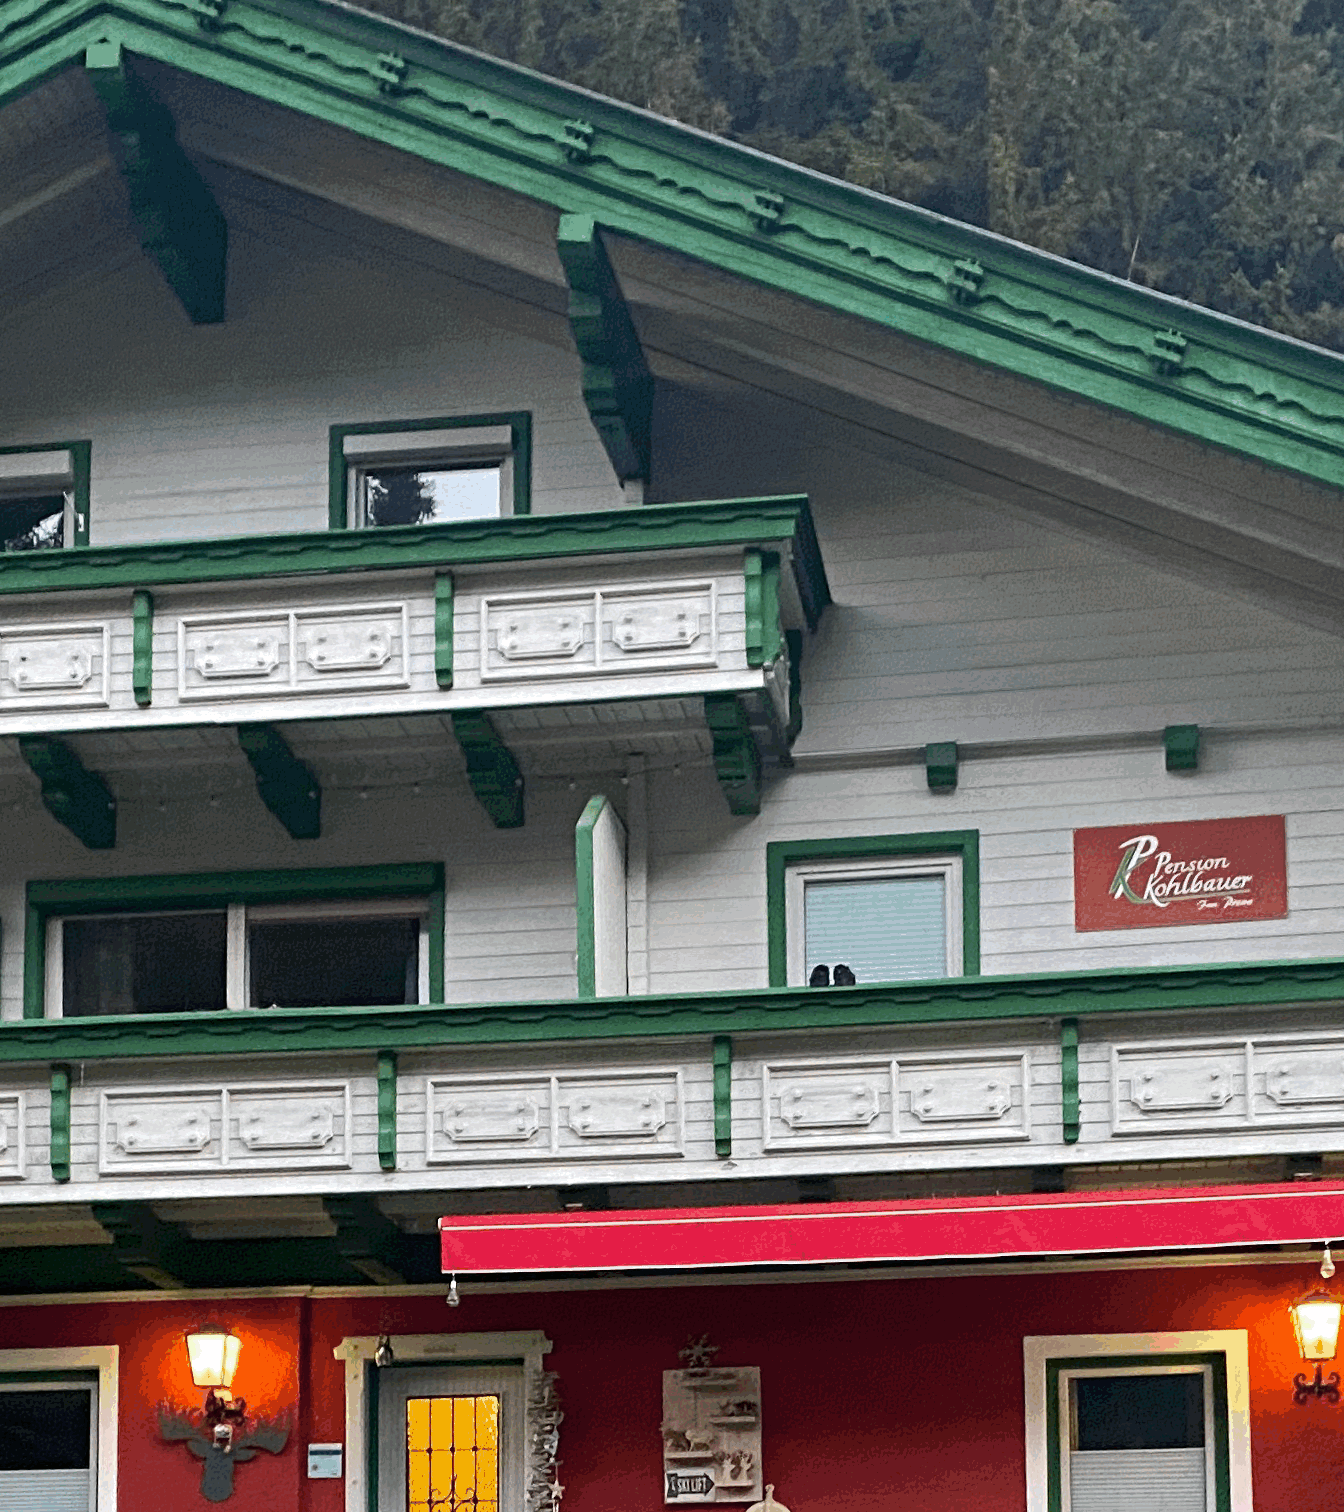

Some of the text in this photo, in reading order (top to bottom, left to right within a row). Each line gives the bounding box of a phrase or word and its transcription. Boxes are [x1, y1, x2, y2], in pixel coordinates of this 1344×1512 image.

[1154, 851, 1231, 878] Pension
[1143, 870, 1253, 908] Kohlbauer
[677, 1478, 690, 1494] SKI
[690, 1477, 707, 1493] LIFT
